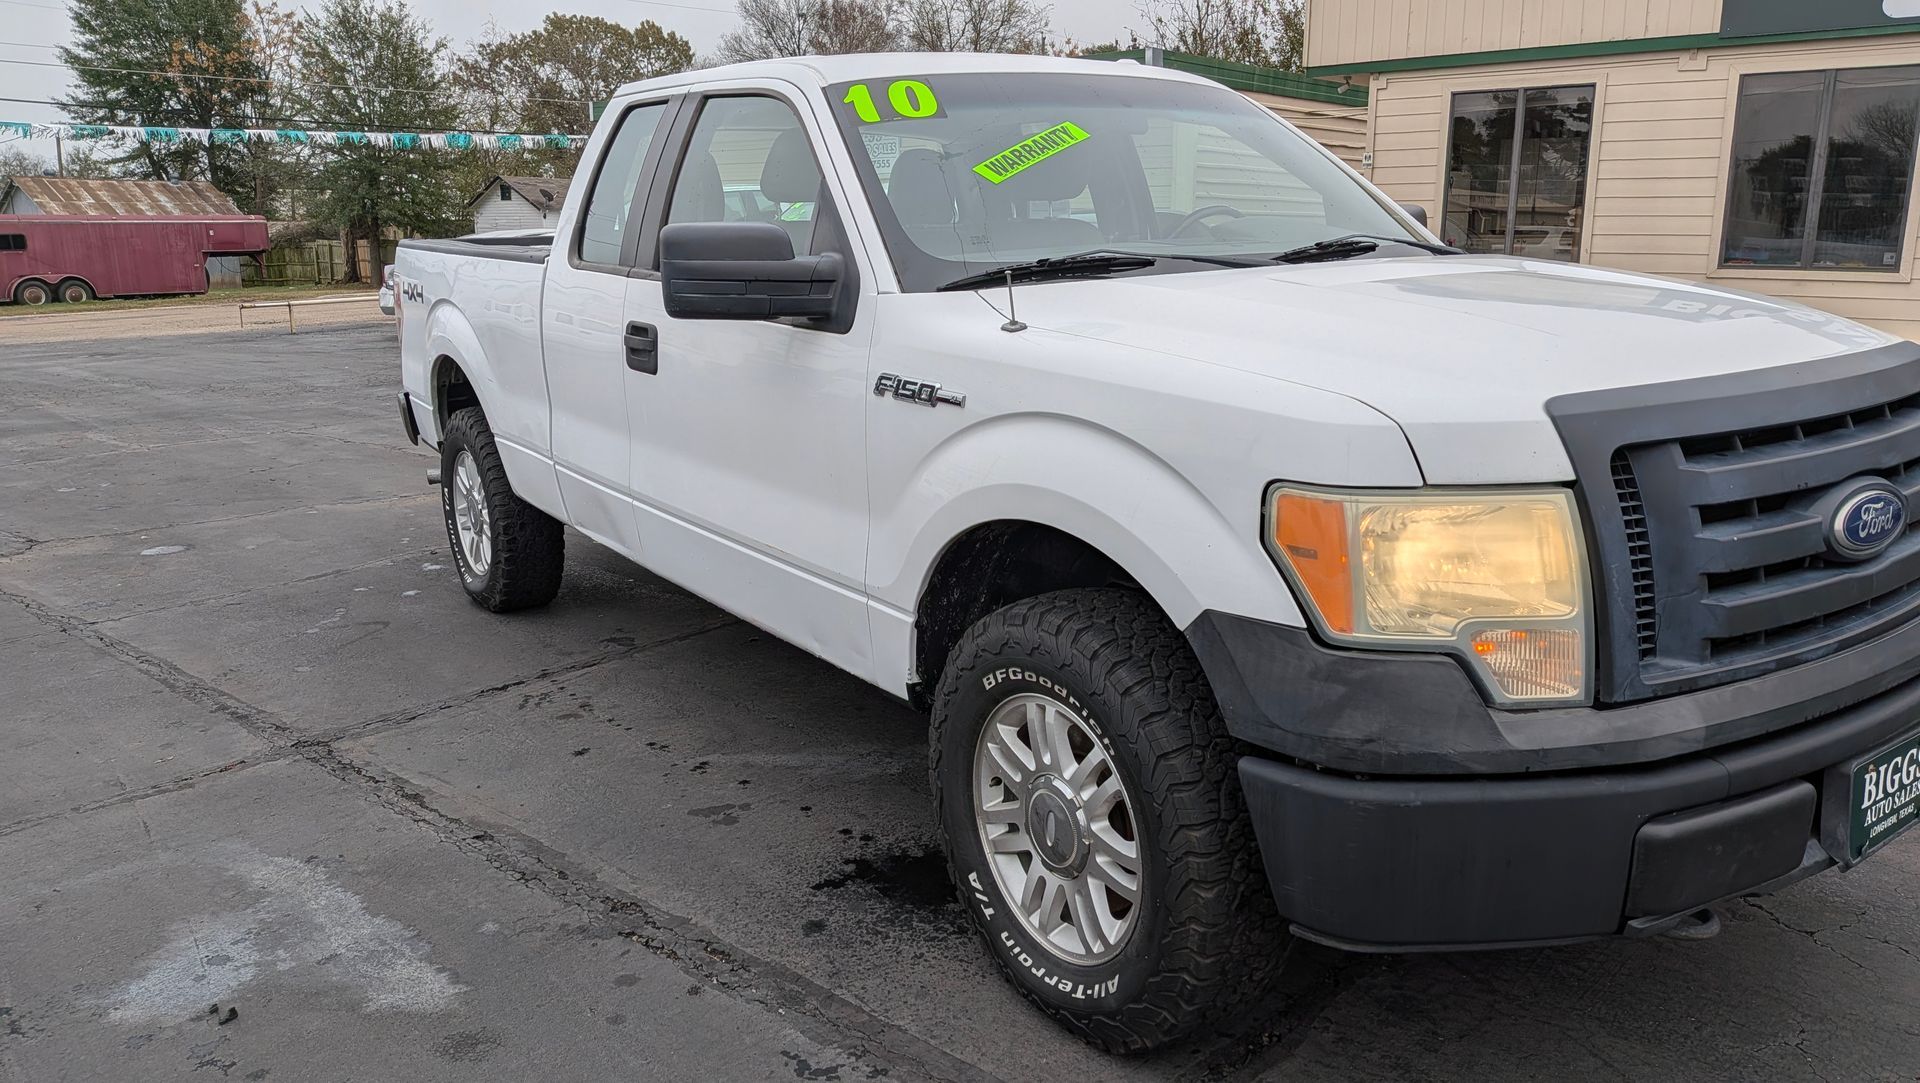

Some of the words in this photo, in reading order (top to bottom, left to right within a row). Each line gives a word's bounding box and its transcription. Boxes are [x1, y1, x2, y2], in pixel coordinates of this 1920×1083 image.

[843, 80, 938, 123] 10
[983, 124, 1076, 177] WARRANTY
[1859, 501, 1894, 538] Ford
[982, 667, 1115, 756] BFGoodrich
[1864, 796, 1893, 827] AUTO
[1899, 802, 1915, 821] TEXAS
[968, 871, 995, 921] T/A
[1001, 931, 1120, 999] All-Terrain
